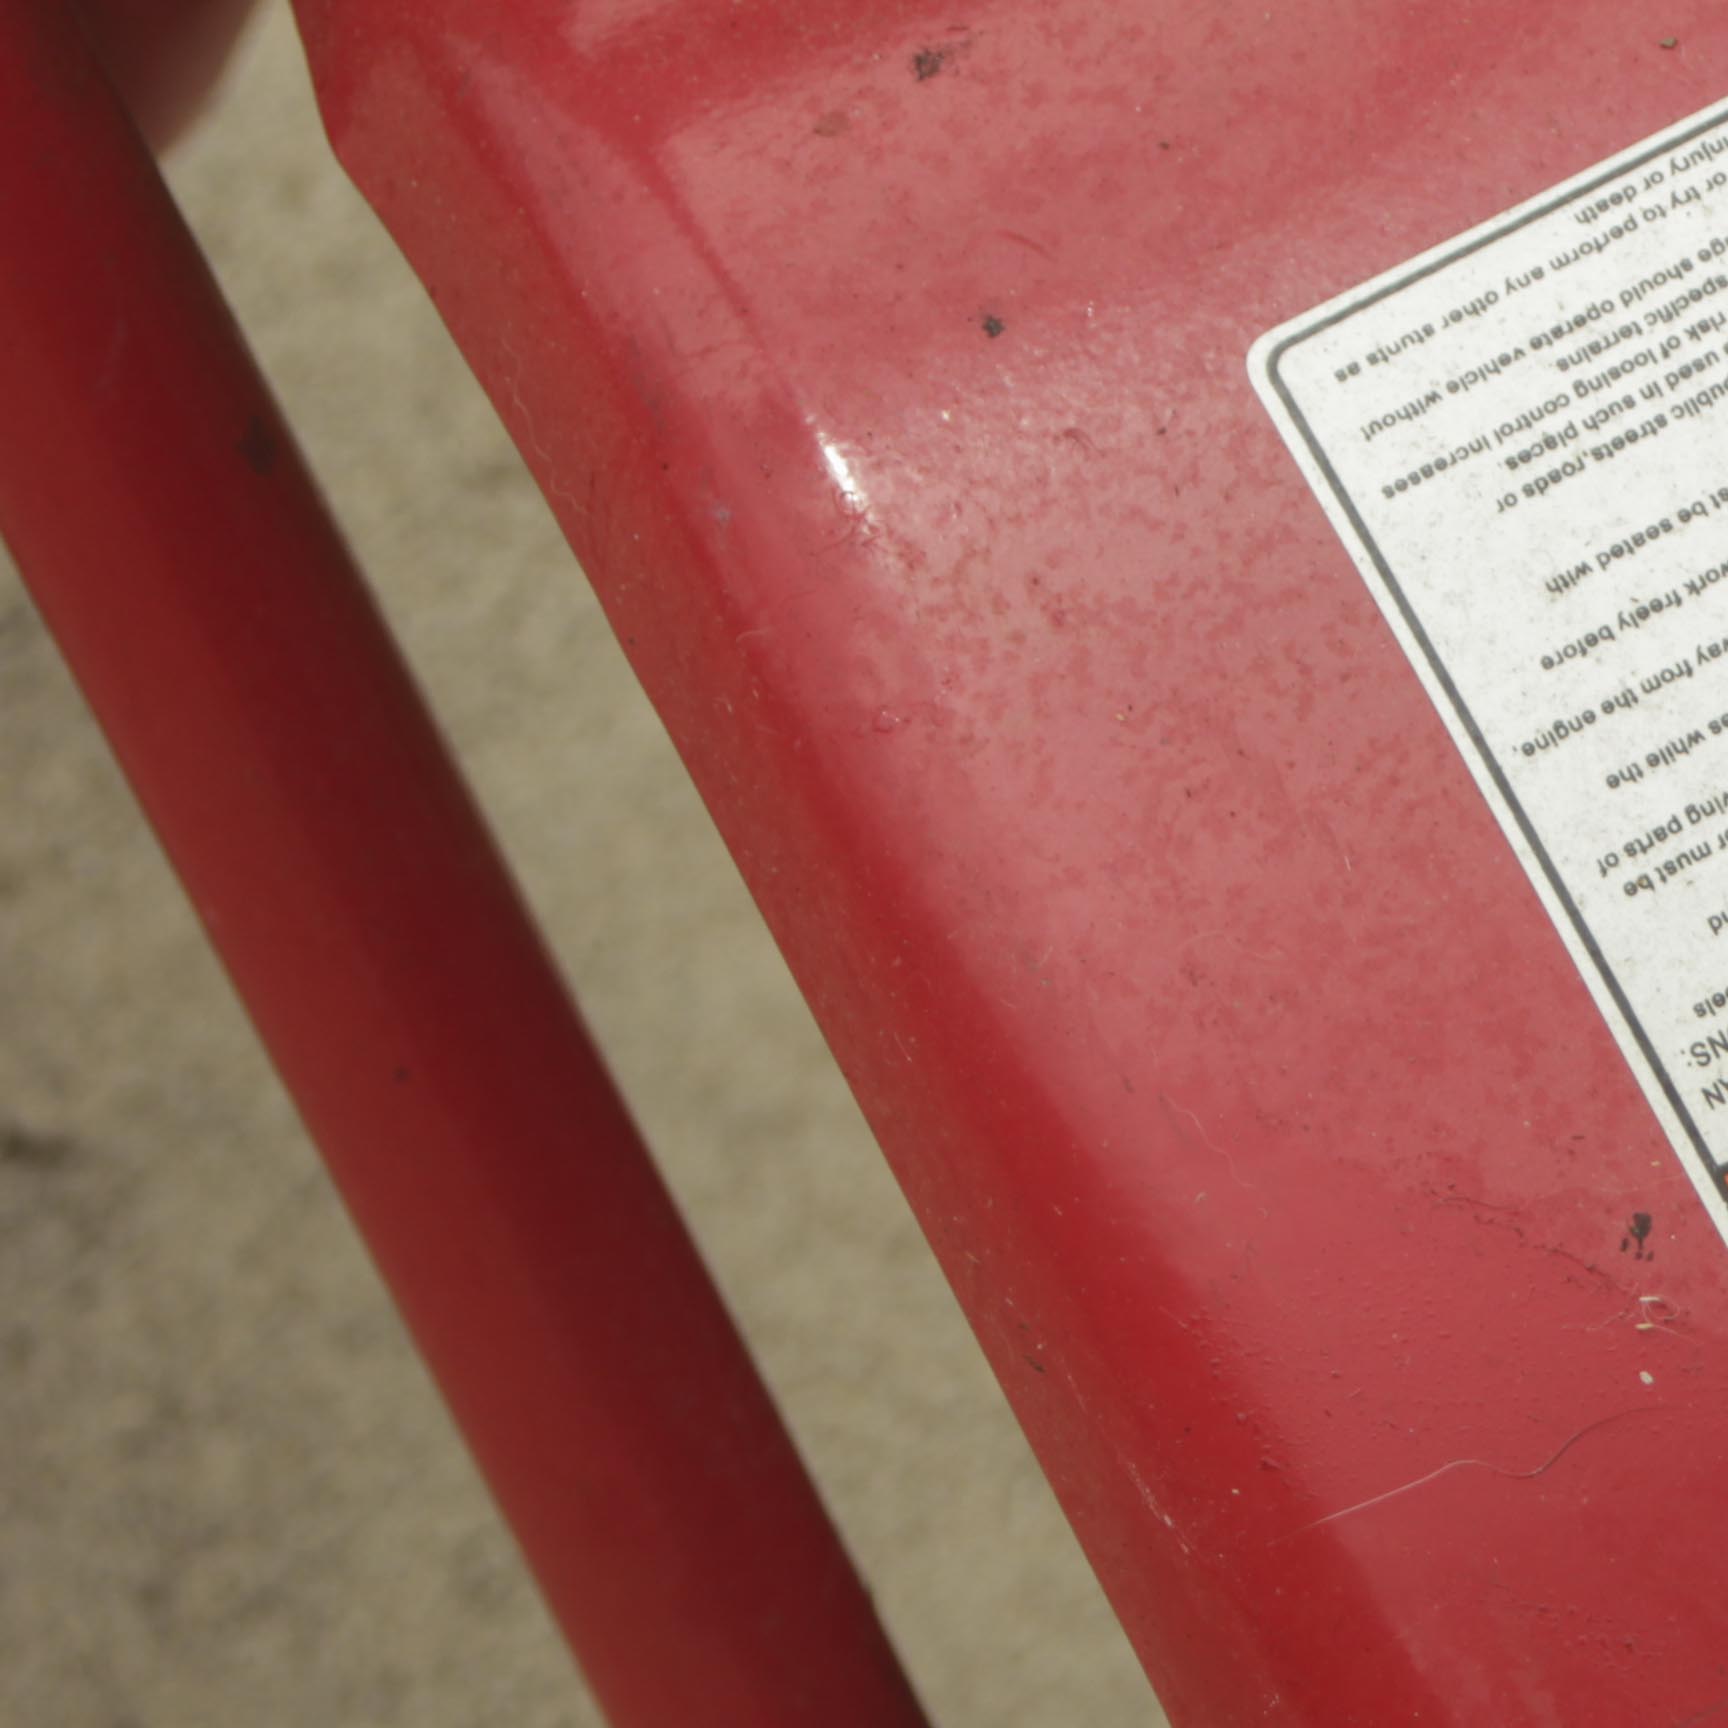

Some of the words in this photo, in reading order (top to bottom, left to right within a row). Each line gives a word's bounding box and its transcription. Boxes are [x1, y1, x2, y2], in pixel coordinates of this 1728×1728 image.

[1574, 184, 1637, 224] death
[1548, 213, 1639, 271] perform
[1618, 257, 1694, 309] should
[1643, 274, 1728, 326] specific
[1441, 289, 1499, 329] other
[1527, 298, 1615, 351] operate
[1683, 310, 1727, 342] risk
[1364, 322, 1436, 367] stunts
[1444, 346, 1527, 395] vehicle
[1571, 348, 1658, 399] loosing
[1663, 350, 1720, 391] used
[1359, 389, 1443, 442] without
[1492, 392, 1571, 445] control
[1581, 393, 1636, 431] such
[1380, 434, 1492, 500] increases
[1594, 516, 1675, 572] seated
[1543, 560, 1594, 595] with
[1616, 588, 1683, 632] freely
[1539, 623, 1617, 671] before
[1639, 658, 1694, 695] from
[1599, 686, 1640, 715] the
[1644, 728, 1707, 769] while
[1604, 761, 1645, 790] the
[1622, 813, 1684, 859] parts
[1652, 840, 1713, 884] must
